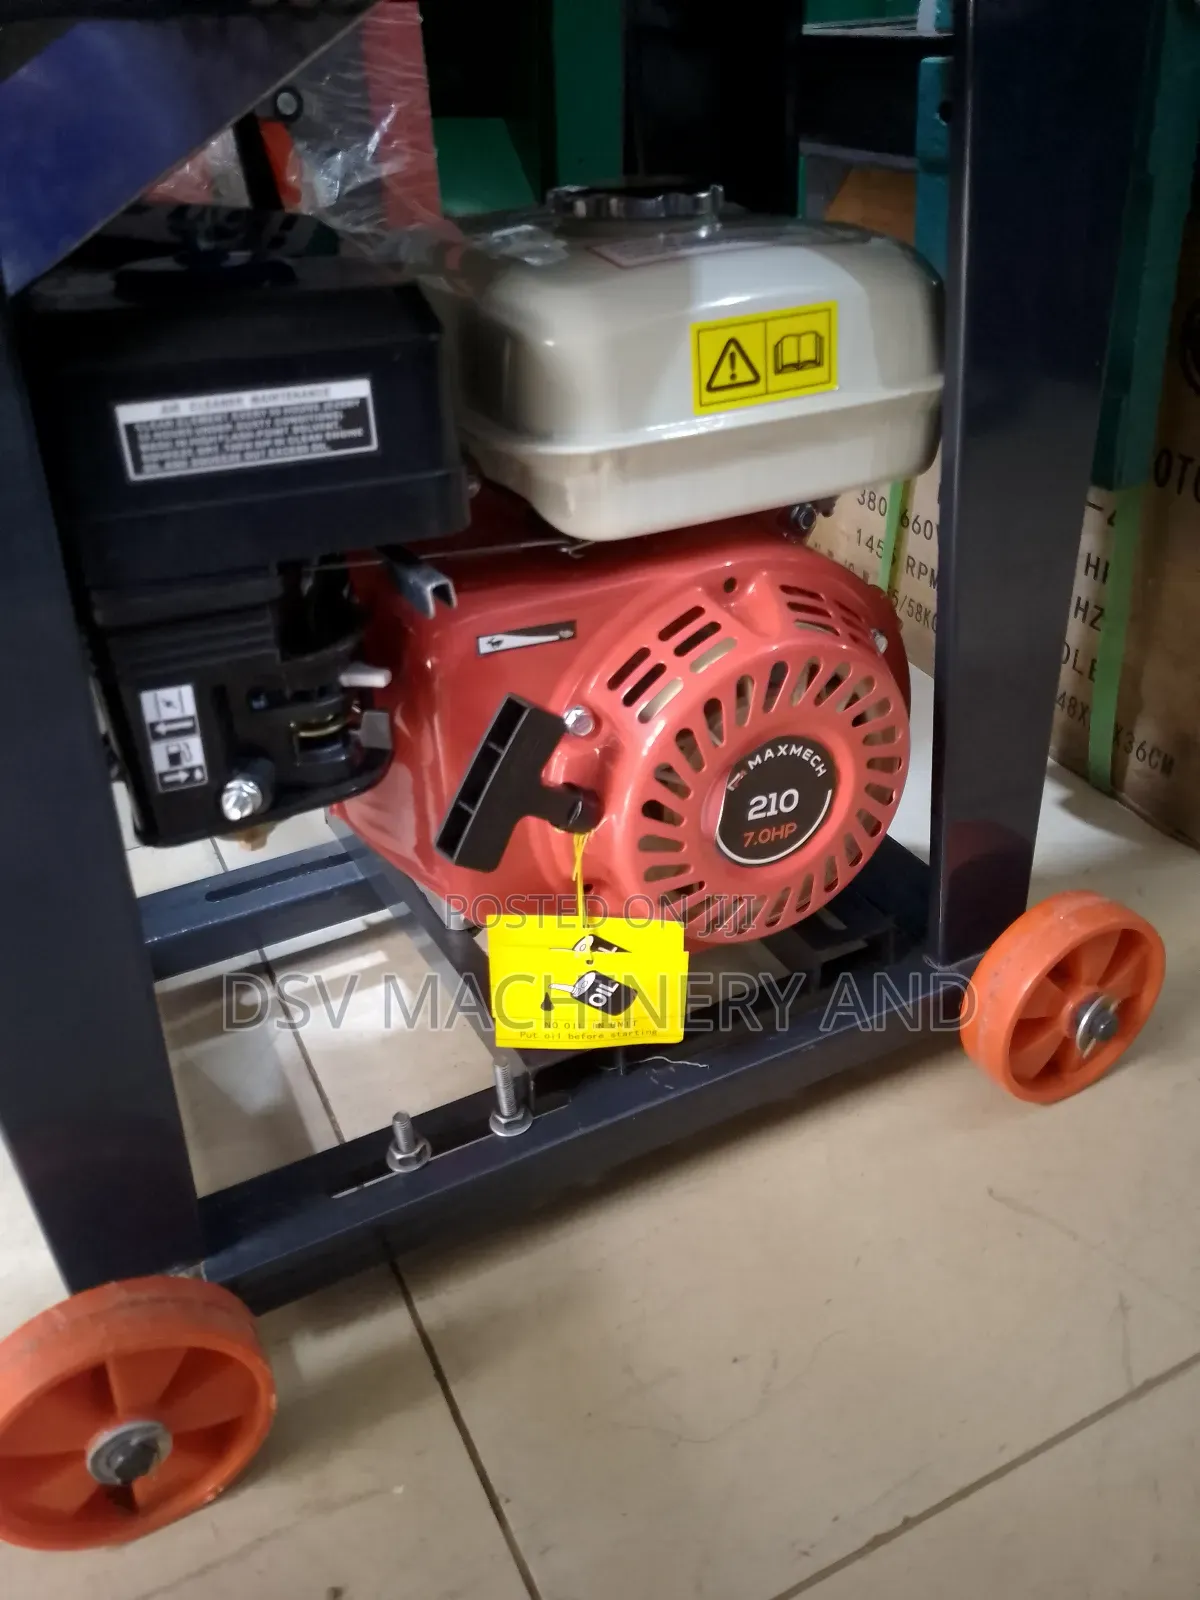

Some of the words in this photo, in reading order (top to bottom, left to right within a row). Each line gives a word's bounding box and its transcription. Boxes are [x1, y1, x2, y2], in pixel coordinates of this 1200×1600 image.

[747, 743, 827, 777] MAXMECH
[747, 788, 799, 821] 210
[743, 822, 797, 848] 7.0HP
[588, 983, 620, 1007] OIL
[519, 1031, 538, 1039] Put
[568, 1032, 605, 1040] before
[610, 1030, 658, 1039] starting
